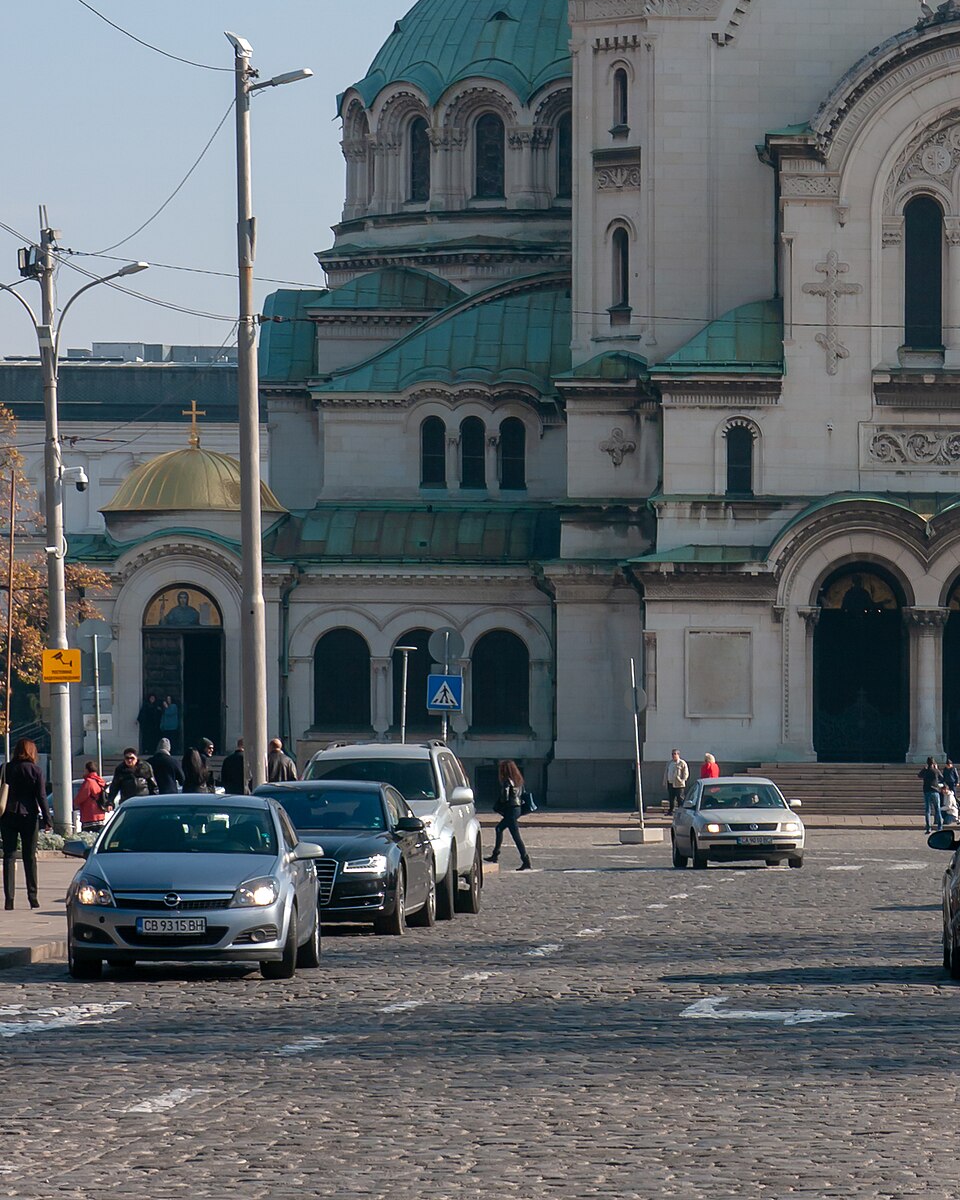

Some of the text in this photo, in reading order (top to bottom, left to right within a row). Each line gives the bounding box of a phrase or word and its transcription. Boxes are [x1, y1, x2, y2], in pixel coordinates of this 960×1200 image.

[144, 920, 204, 931] CB 9315 BH
